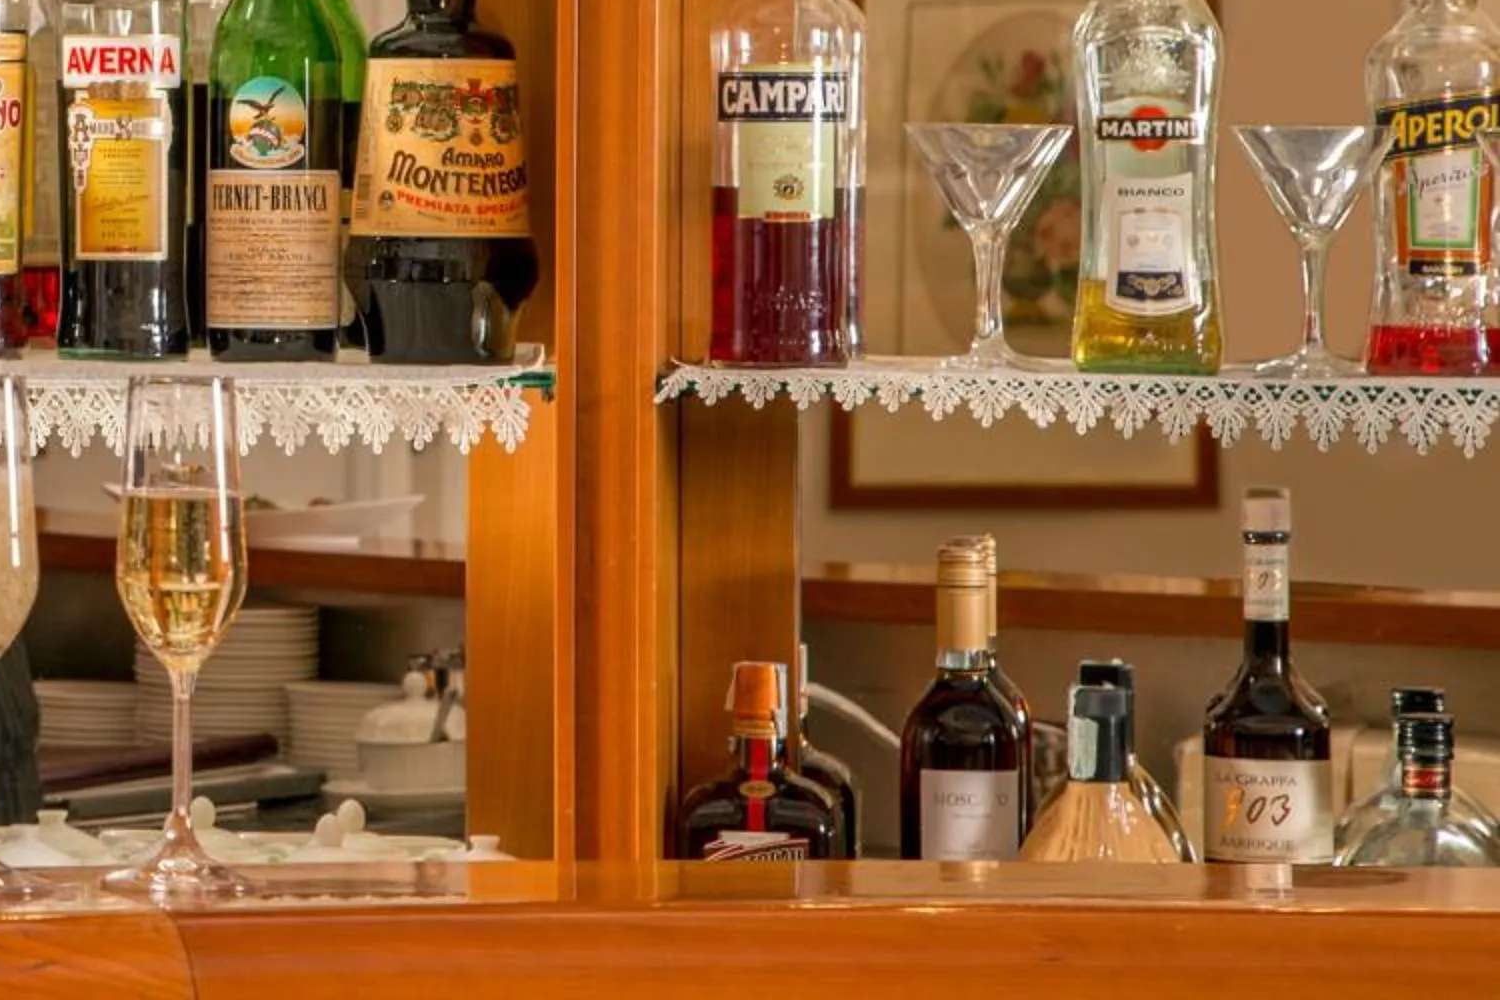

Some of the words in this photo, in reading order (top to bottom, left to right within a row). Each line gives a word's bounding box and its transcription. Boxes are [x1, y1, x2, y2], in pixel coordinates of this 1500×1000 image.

[68, 47, 175, 73] AVERNA
[722, 80, 845, 114] CAMPARI
[1101, 120, 1197, 138] MARTINI
[1391, 103, 1499, 148] APEROL
[441, 148, 505, 171] AMARO
[396, 190, 471, 214] PREMIATA
[1117, 187, 1185, 197] BIANCO
[1235, 773, 1298, 787] GRAPPA
